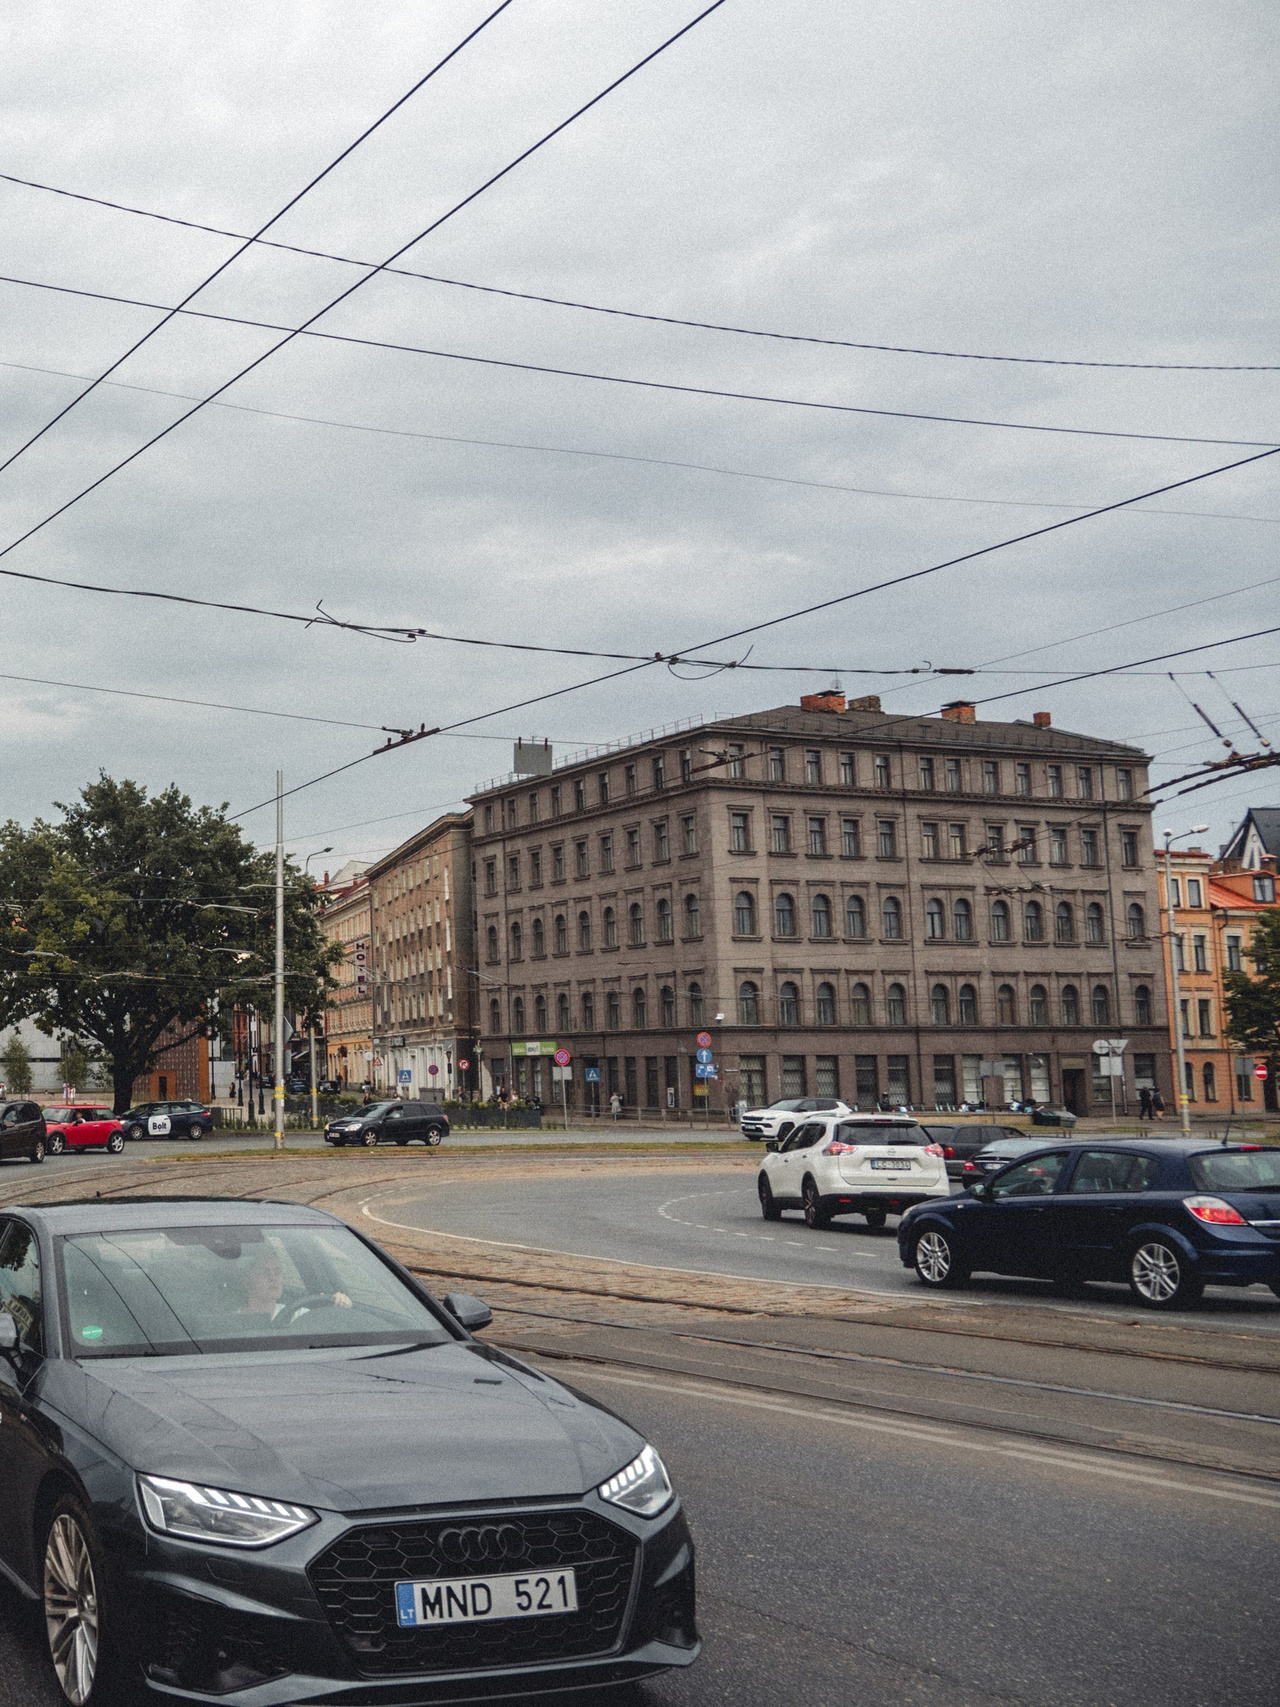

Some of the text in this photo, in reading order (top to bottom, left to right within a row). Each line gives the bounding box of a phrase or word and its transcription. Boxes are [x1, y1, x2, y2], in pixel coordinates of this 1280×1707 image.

[152, 1122, 166, 1130] Bolt
[421, 1575, 569, 1620] MND 521
[400, 1608, 415, 1619] LT
